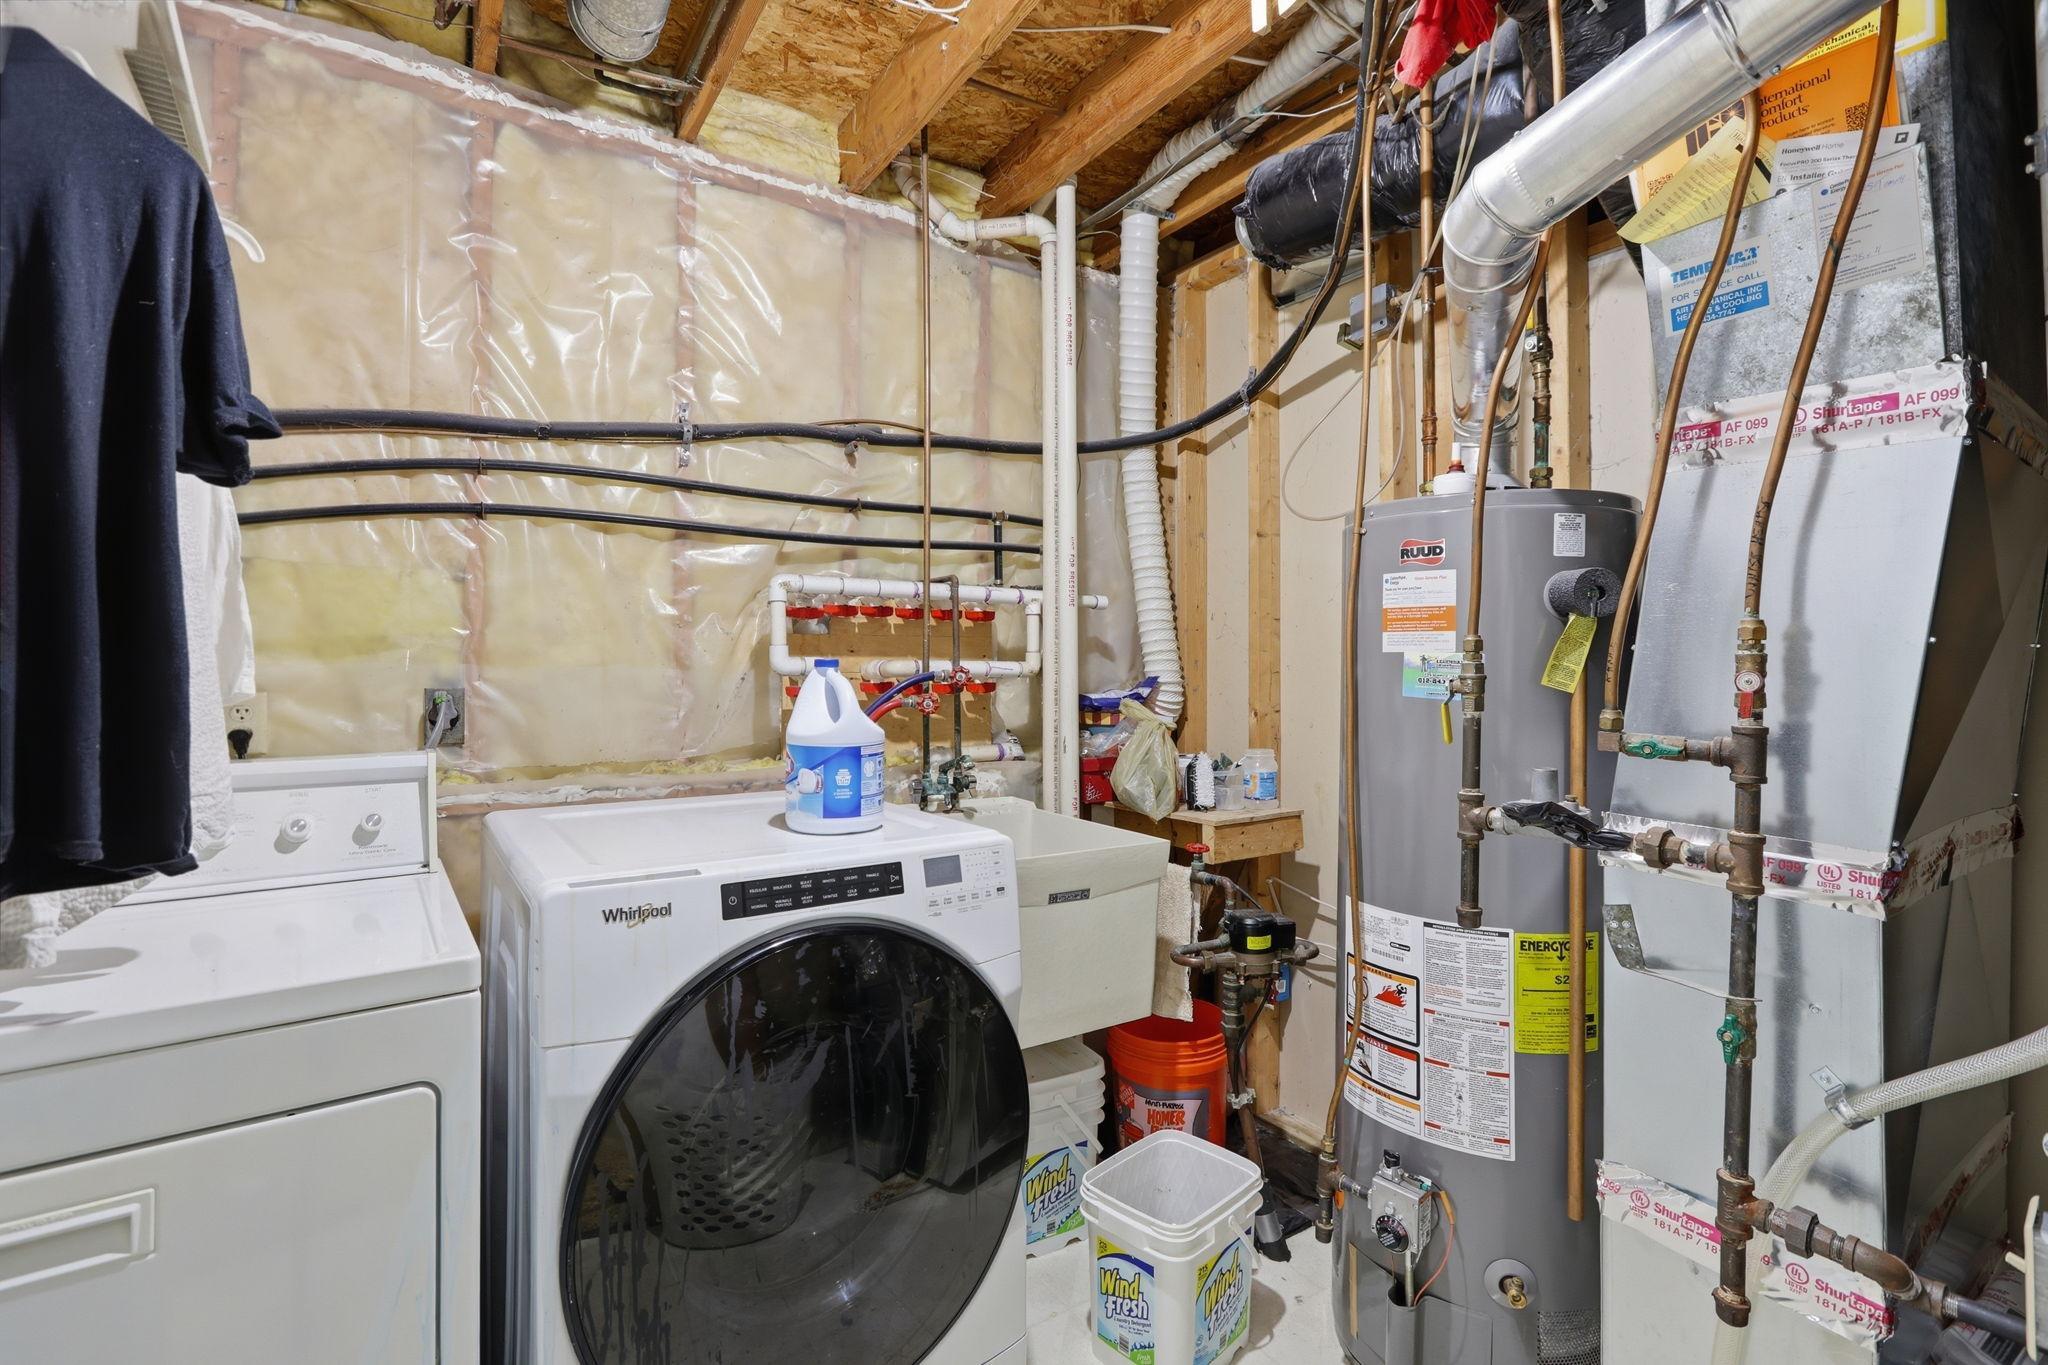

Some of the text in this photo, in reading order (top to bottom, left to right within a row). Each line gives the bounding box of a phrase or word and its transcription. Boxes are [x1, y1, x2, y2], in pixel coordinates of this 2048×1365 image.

[1814, 22, 1875, 52] echanical,
[1759, 69, 1832, 106] nternational
[1760, 93, 1804, 119] omfort
[1760, 107, 1809, 130] roducts
[1781, 144, 1821, 155] Honeywell
[1790, 170, 1826, 182] Installer
[1670, 247, 1759, 284] TEMPTAR
[1671, 271, 1764, 304] FOR SICE CALL
[1675, 285, 1764, 316] AIR MANICAL INC
[1676, 292, 1763, 323] HEAG & COOLING
[1813, 387, 1960, 420] Shurtape AF 099
[1724, 421, 1742, 434] AF
[1745, 417, 1769, 431] 099
[1815, 418, 1864, 435] 181A-P
[1878, 407, 1942, 425] 181B-FX
[1400, 545, 1444, 560] RUUD
[1816, 880, 1842, 891] LISTED
[602, 902, 672, 924] Whirlpool
[1367, 965, 1393, 980] WARNING
[1147, 1108, 1186, 1126] HOMER
[1027, 1153, 1069, 1206] Wind
[1031, 1168, 1076, 1223] Fresh
[1654, 1202, 1711, 1237] Shurtape
[1654, 1217, 1693, 1241] 181A-P
[1100, 1267, 1141, 1300] Wind
[1204, 1246, 1240, 1321] Wind
[1784, 1279, 1808, 1294] LISTED
[1791, 1266, 1804, 1281] UL
[1105, 1292, 1149, 1320] Fresh
[1207, 1263, 1244, 1341] Fresh
[1815, 1295, 1864, 1323] 181A-P
